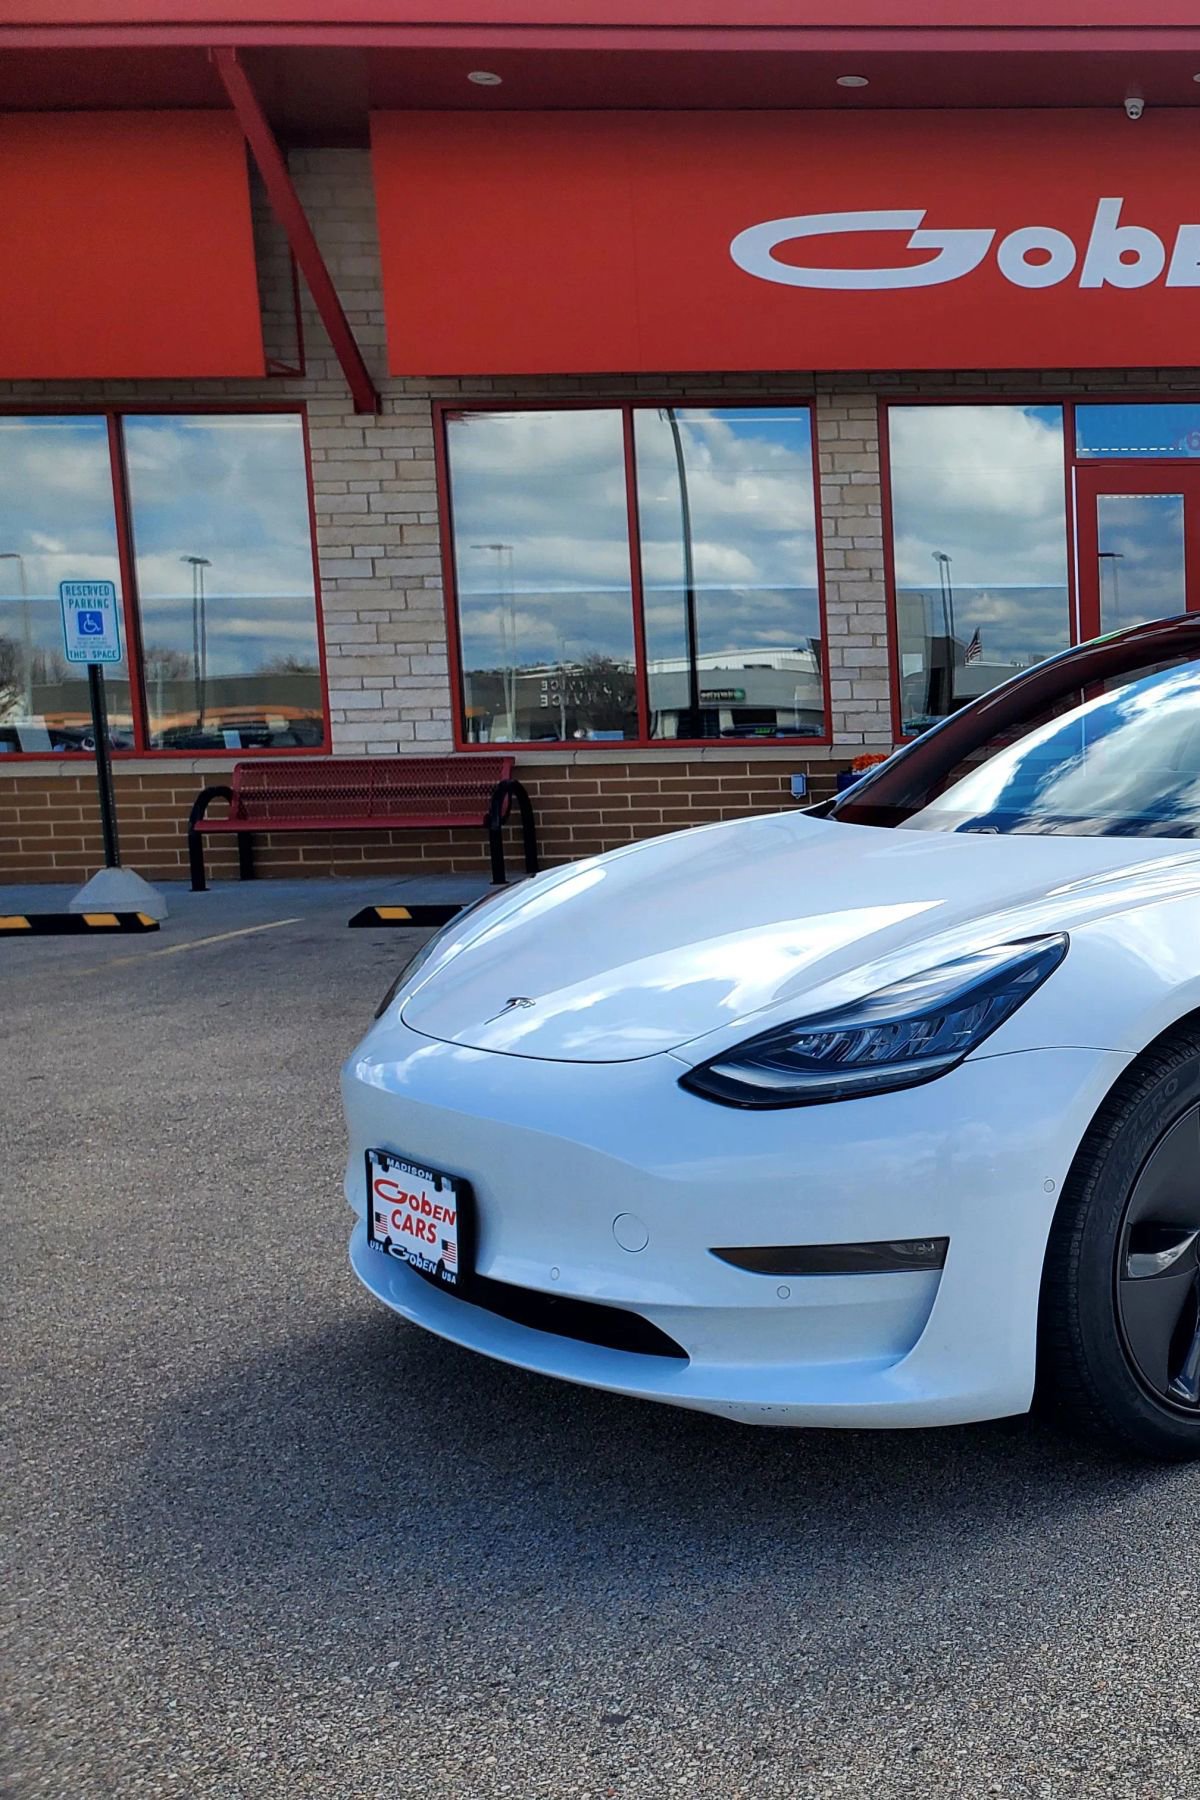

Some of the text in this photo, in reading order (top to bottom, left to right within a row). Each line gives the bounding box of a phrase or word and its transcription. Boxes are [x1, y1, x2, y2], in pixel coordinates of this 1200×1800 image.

[65, 585, 110, 597] RESERVED
[68, 598, 110, 609] PARKING
[69, 649, 117, 659] THIS SPACE
[386, 1157, 434, 1181] MADISON
[391, 1208, 438, 1245] CARS
[370, 1241, 384, 1254] USA
[441, 1270, 457, 1285] USA
